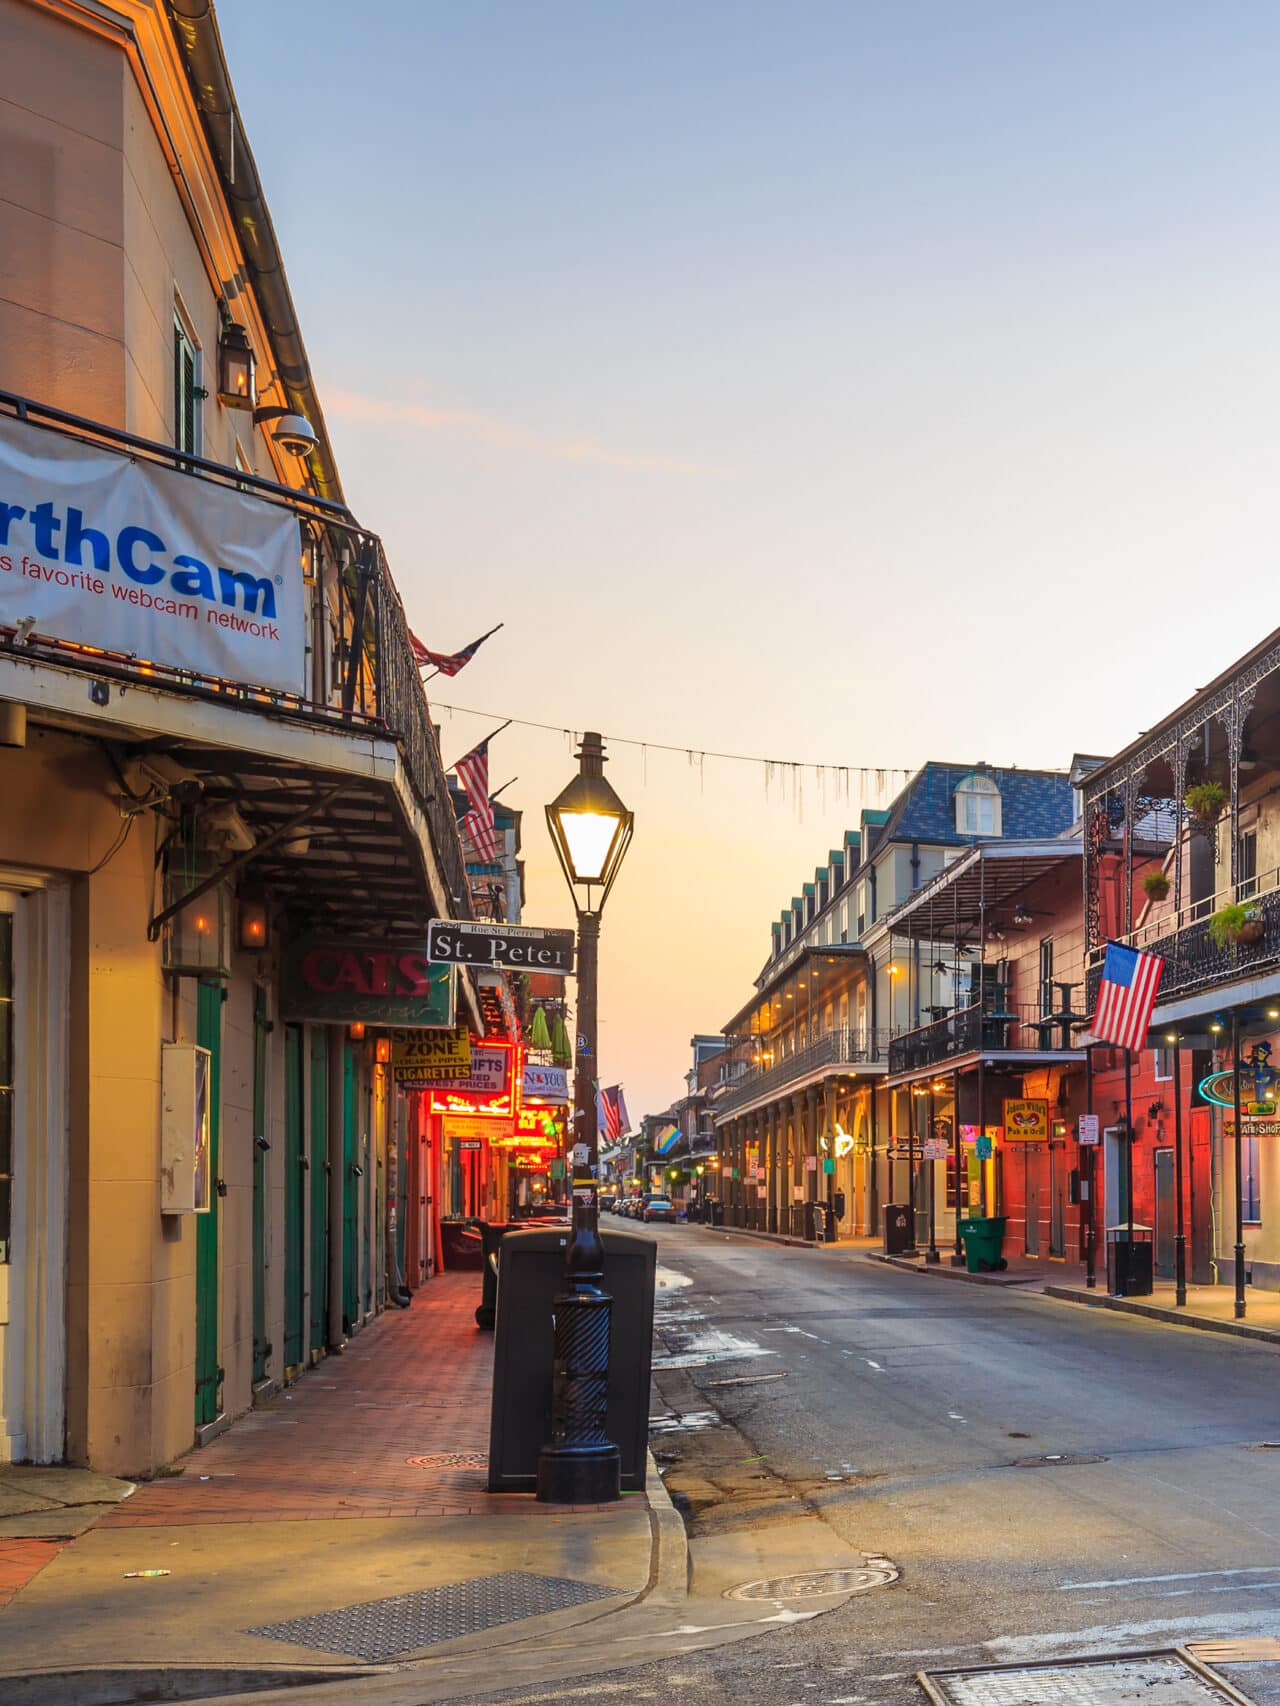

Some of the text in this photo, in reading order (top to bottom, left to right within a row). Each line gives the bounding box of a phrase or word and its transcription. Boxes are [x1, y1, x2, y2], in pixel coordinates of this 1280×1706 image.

[21, 556, 104, 594] favorite
[112, 584, 198, 620] webcam
[207, 608, 280, 640] network
[471, 925, 487, 933] Rue
[507, 928, 536, 937] Pierre
[435, 935, 566, 964] St. Peter
[392, 1026, 467, 1043] SMOKE
[405, 1042, 460, 1056] ZONE
[472, 1059, 502, 1072] IFTS
[396, 1066, 471, 1080] CIGARETTES
[459, 1081, 497, 1089] PRICES
[1259, 1123, 1280, 1134] SHOP
